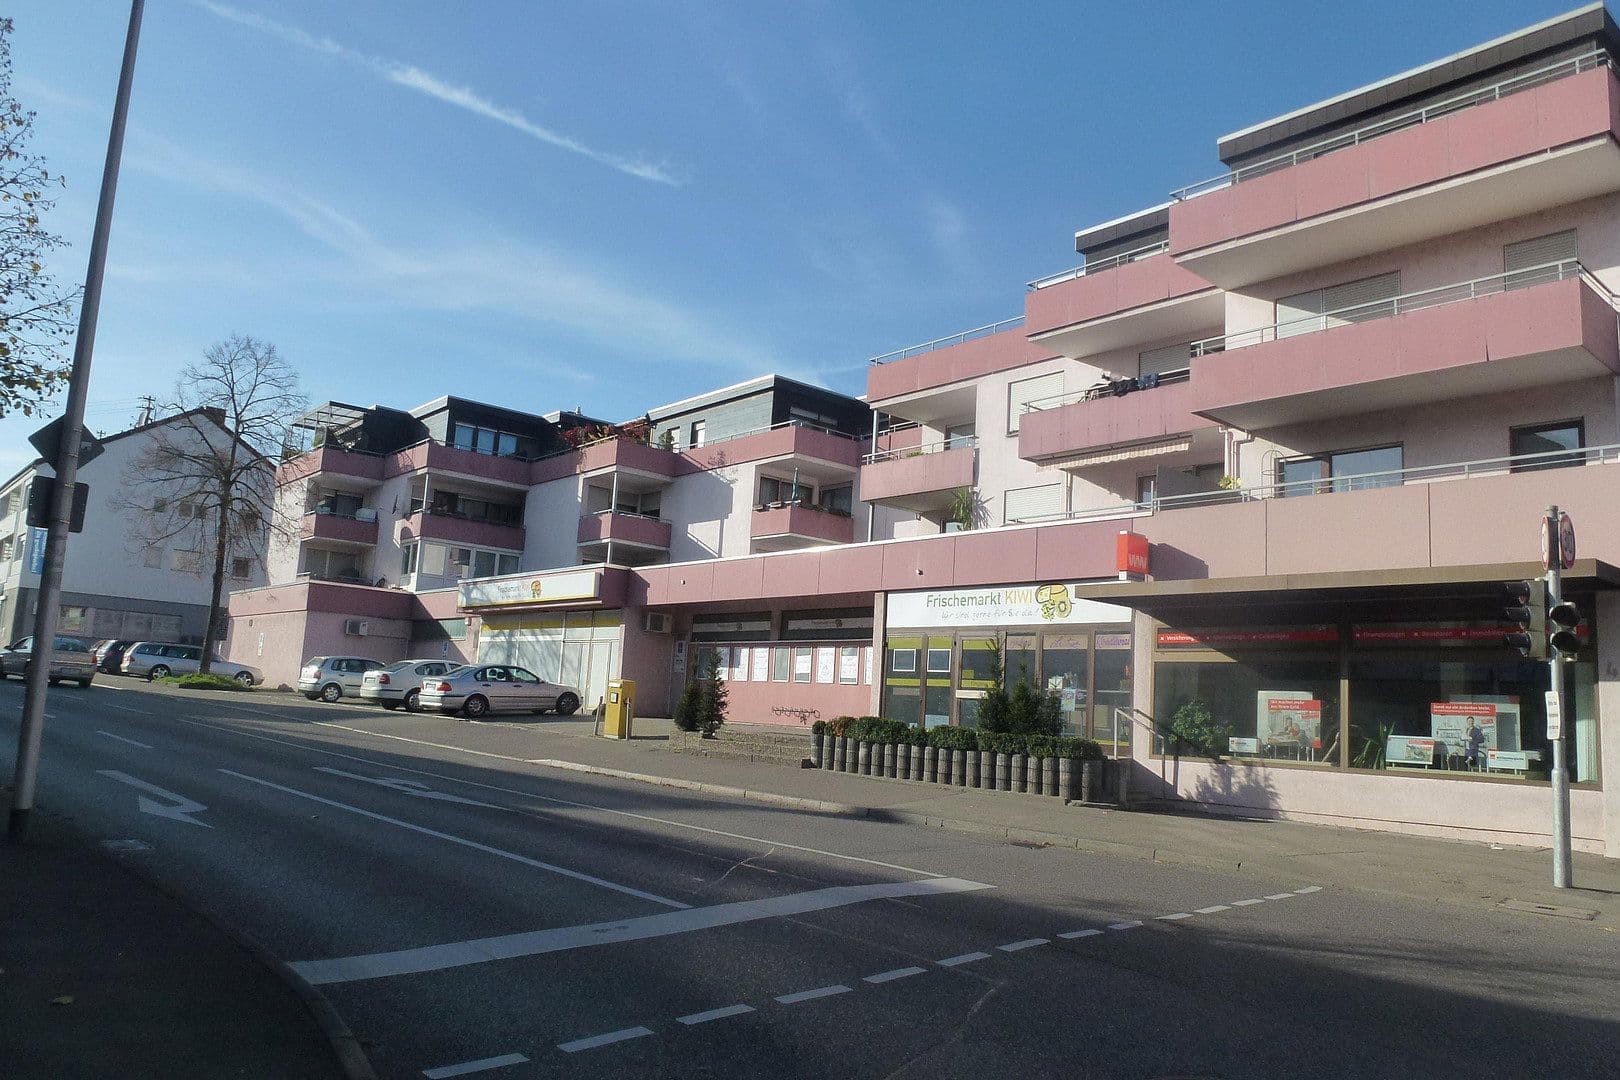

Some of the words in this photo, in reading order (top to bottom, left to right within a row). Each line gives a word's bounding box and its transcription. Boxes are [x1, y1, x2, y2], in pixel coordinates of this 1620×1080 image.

[926, 592, 1001, 608] Frischemarkt
[1005, 590, 1032, 605] KIWI
[942, 611, 954, 619] Wir
